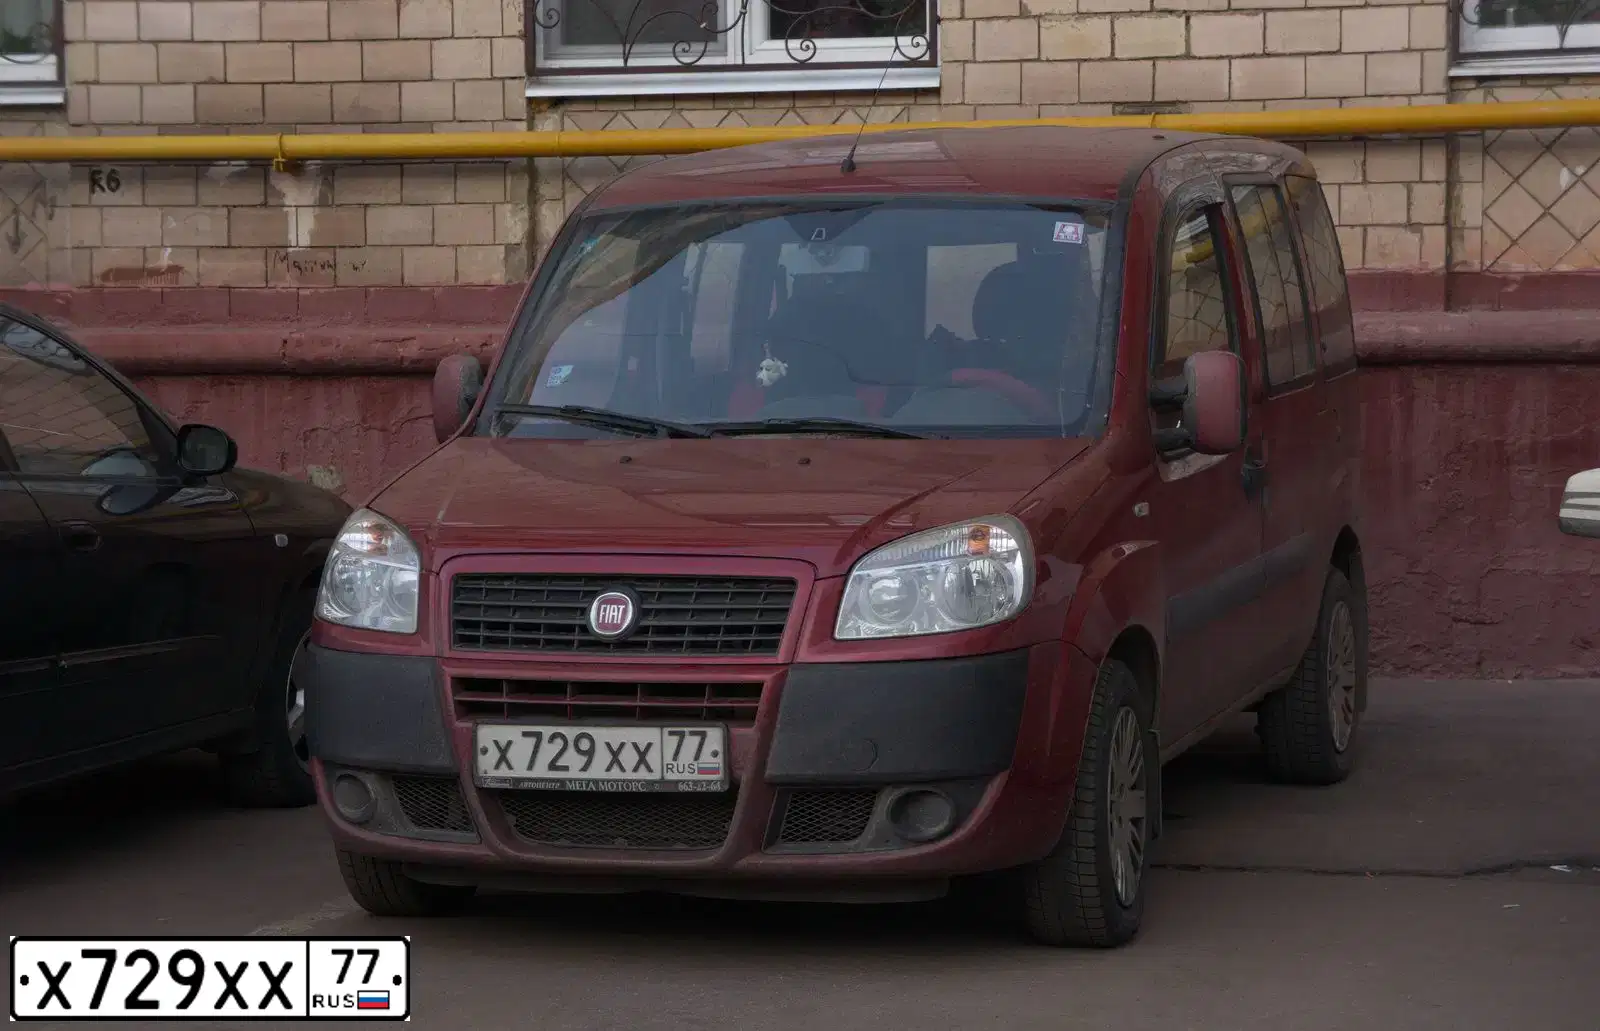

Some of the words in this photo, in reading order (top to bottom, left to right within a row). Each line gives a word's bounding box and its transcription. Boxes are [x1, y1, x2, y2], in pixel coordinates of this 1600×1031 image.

[599, 604, 625, 624] FIAT
[493, 731, 654, 773] Х729ХХ
[668, 730, 708, 762] 77
[665, 762, 696, 775] RUS
[565, 780, 596, 791] МЕГА
[599, 781, 647, 792] МОТОРС
